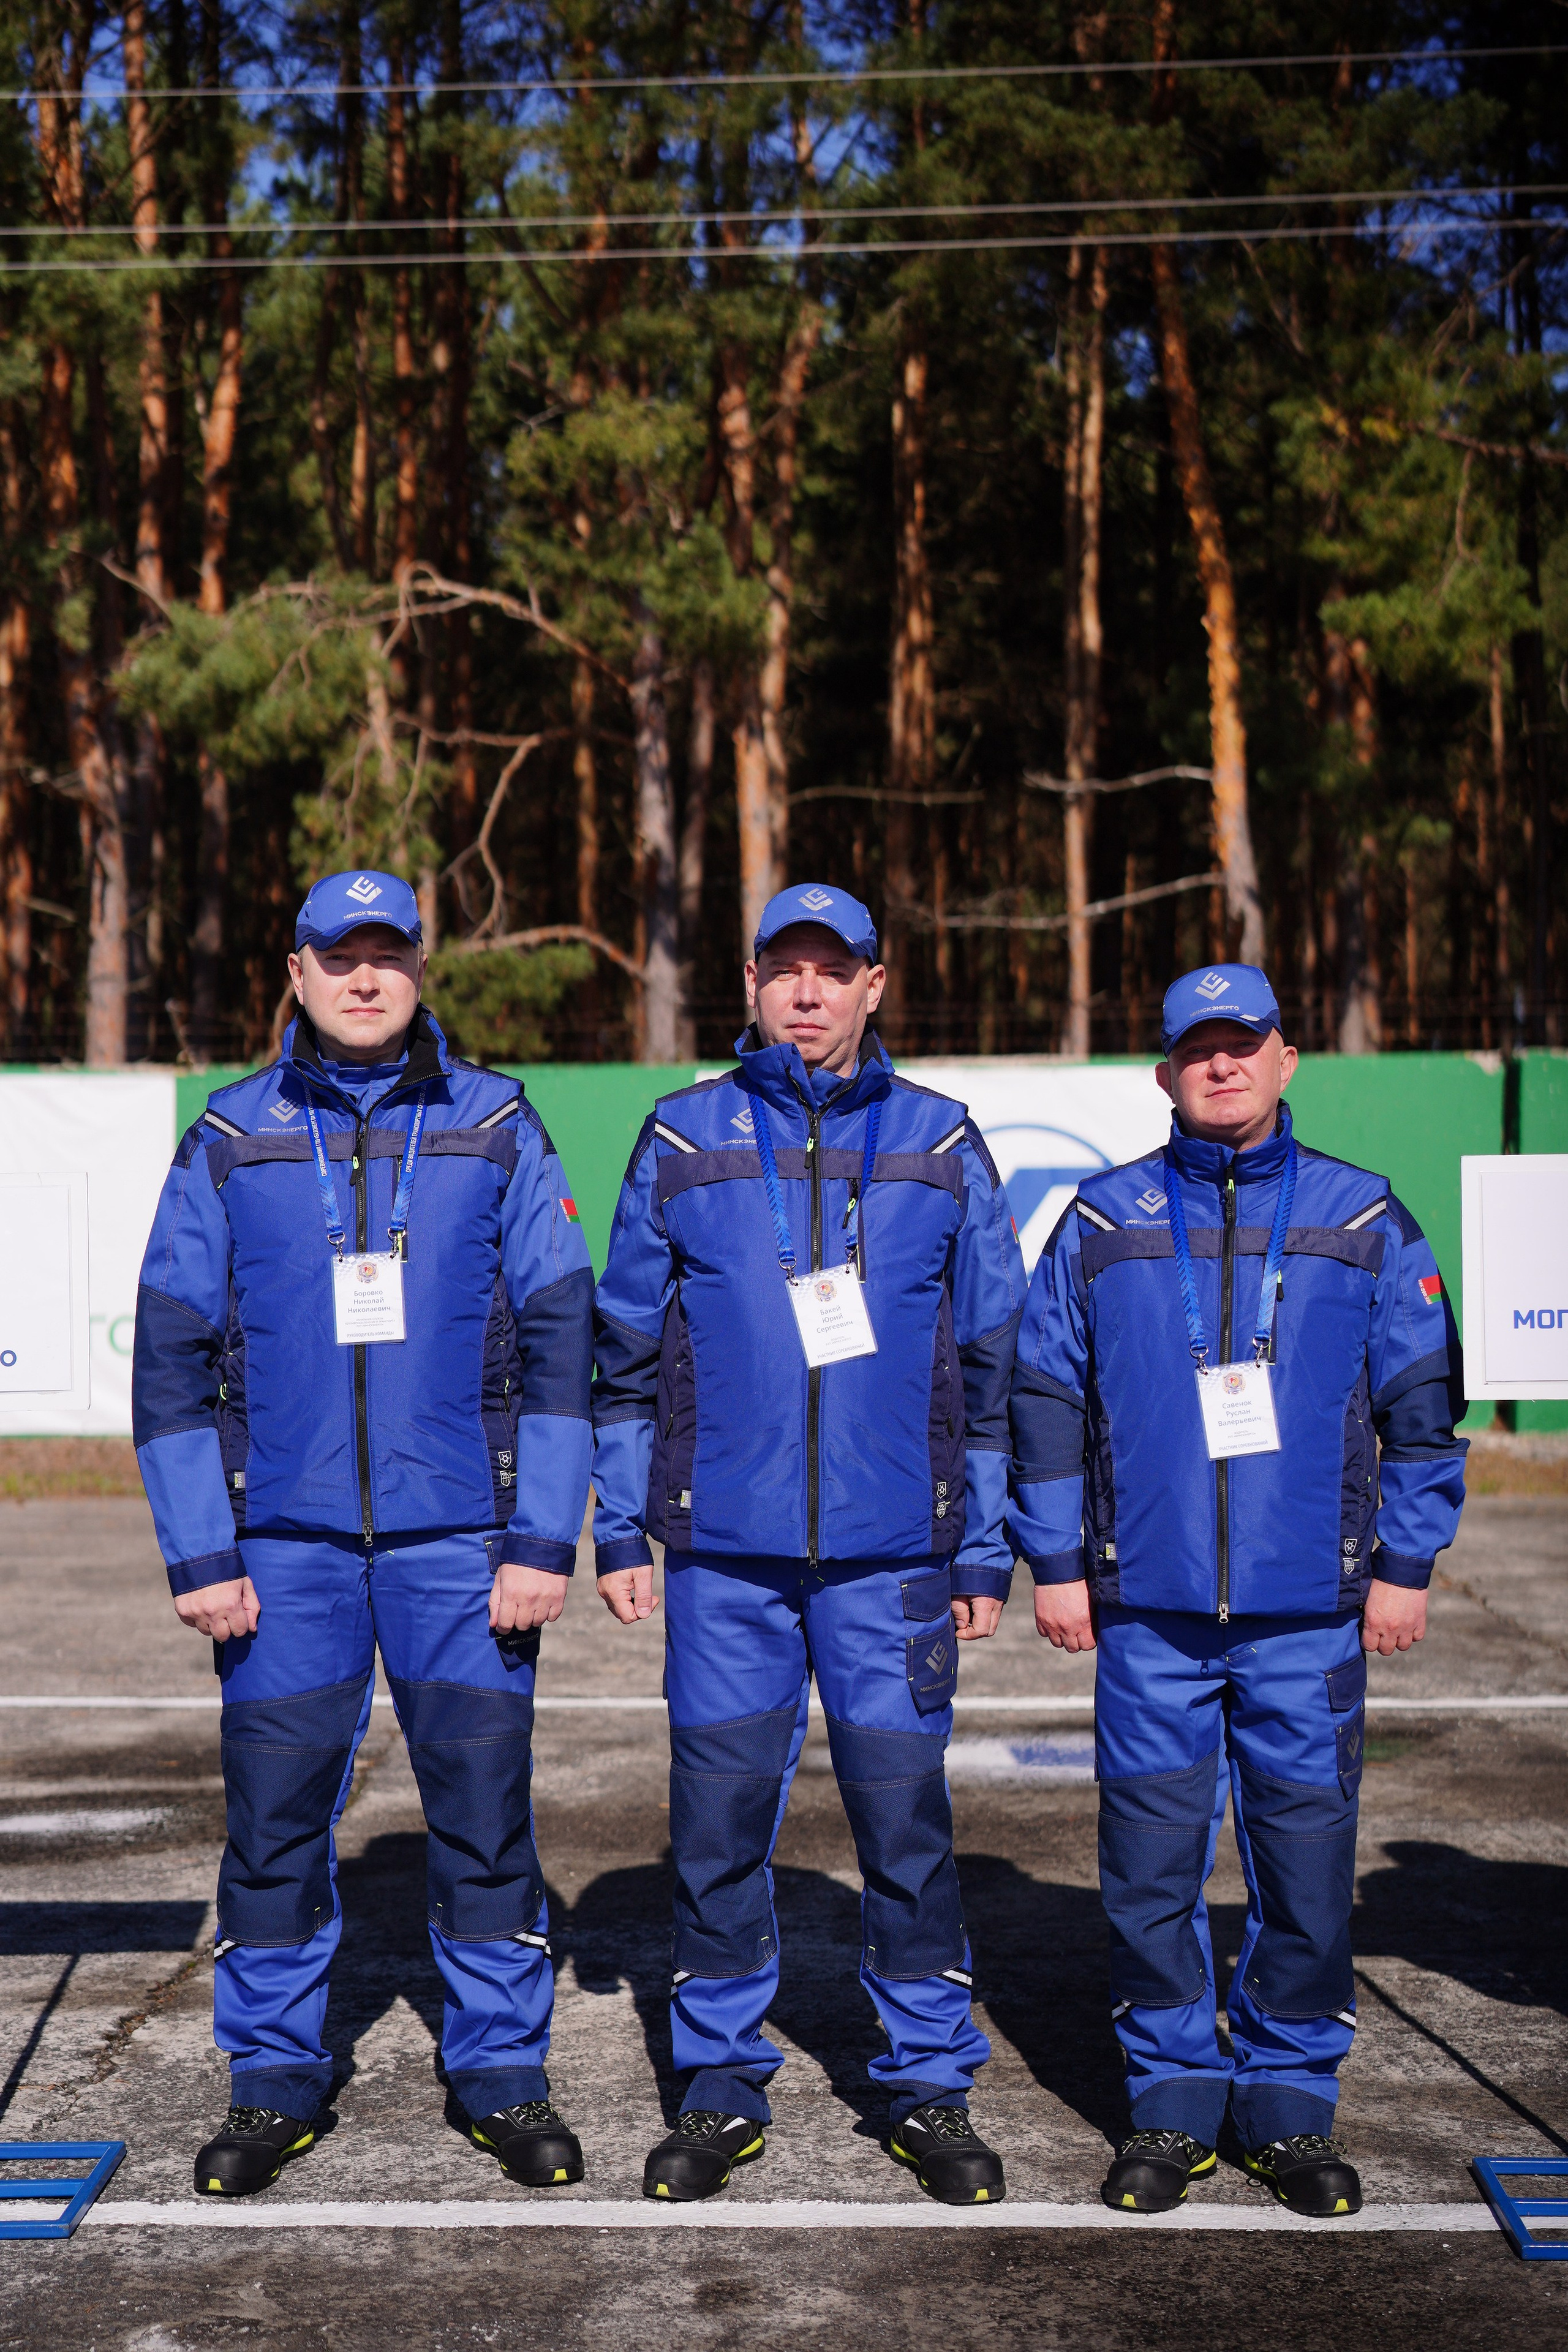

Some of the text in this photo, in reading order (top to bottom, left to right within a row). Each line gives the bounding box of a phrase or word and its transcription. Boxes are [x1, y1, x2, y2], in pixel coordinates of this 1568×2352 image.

[343, 911, 393, 920] МИНСКЭНЕРГО
[820, 1305, 841, 1316] Бакей
[822, 1313, 843, 1324] Юрий
[816, 1321, 853, 1333] Сергеевич
[817, 1342, 865, 1359] УЧАСТНИК СОРЕВНОВАНИЙ
[1222, 1400, 1252, 1409] Савенок
[1226, 1409, 1251, 1418] Руслан
[1218, 1416, 1261, 1426] Валерьевич
[1238, 1439, 1268, 1449] СОРЕВНОВАНИЙ
